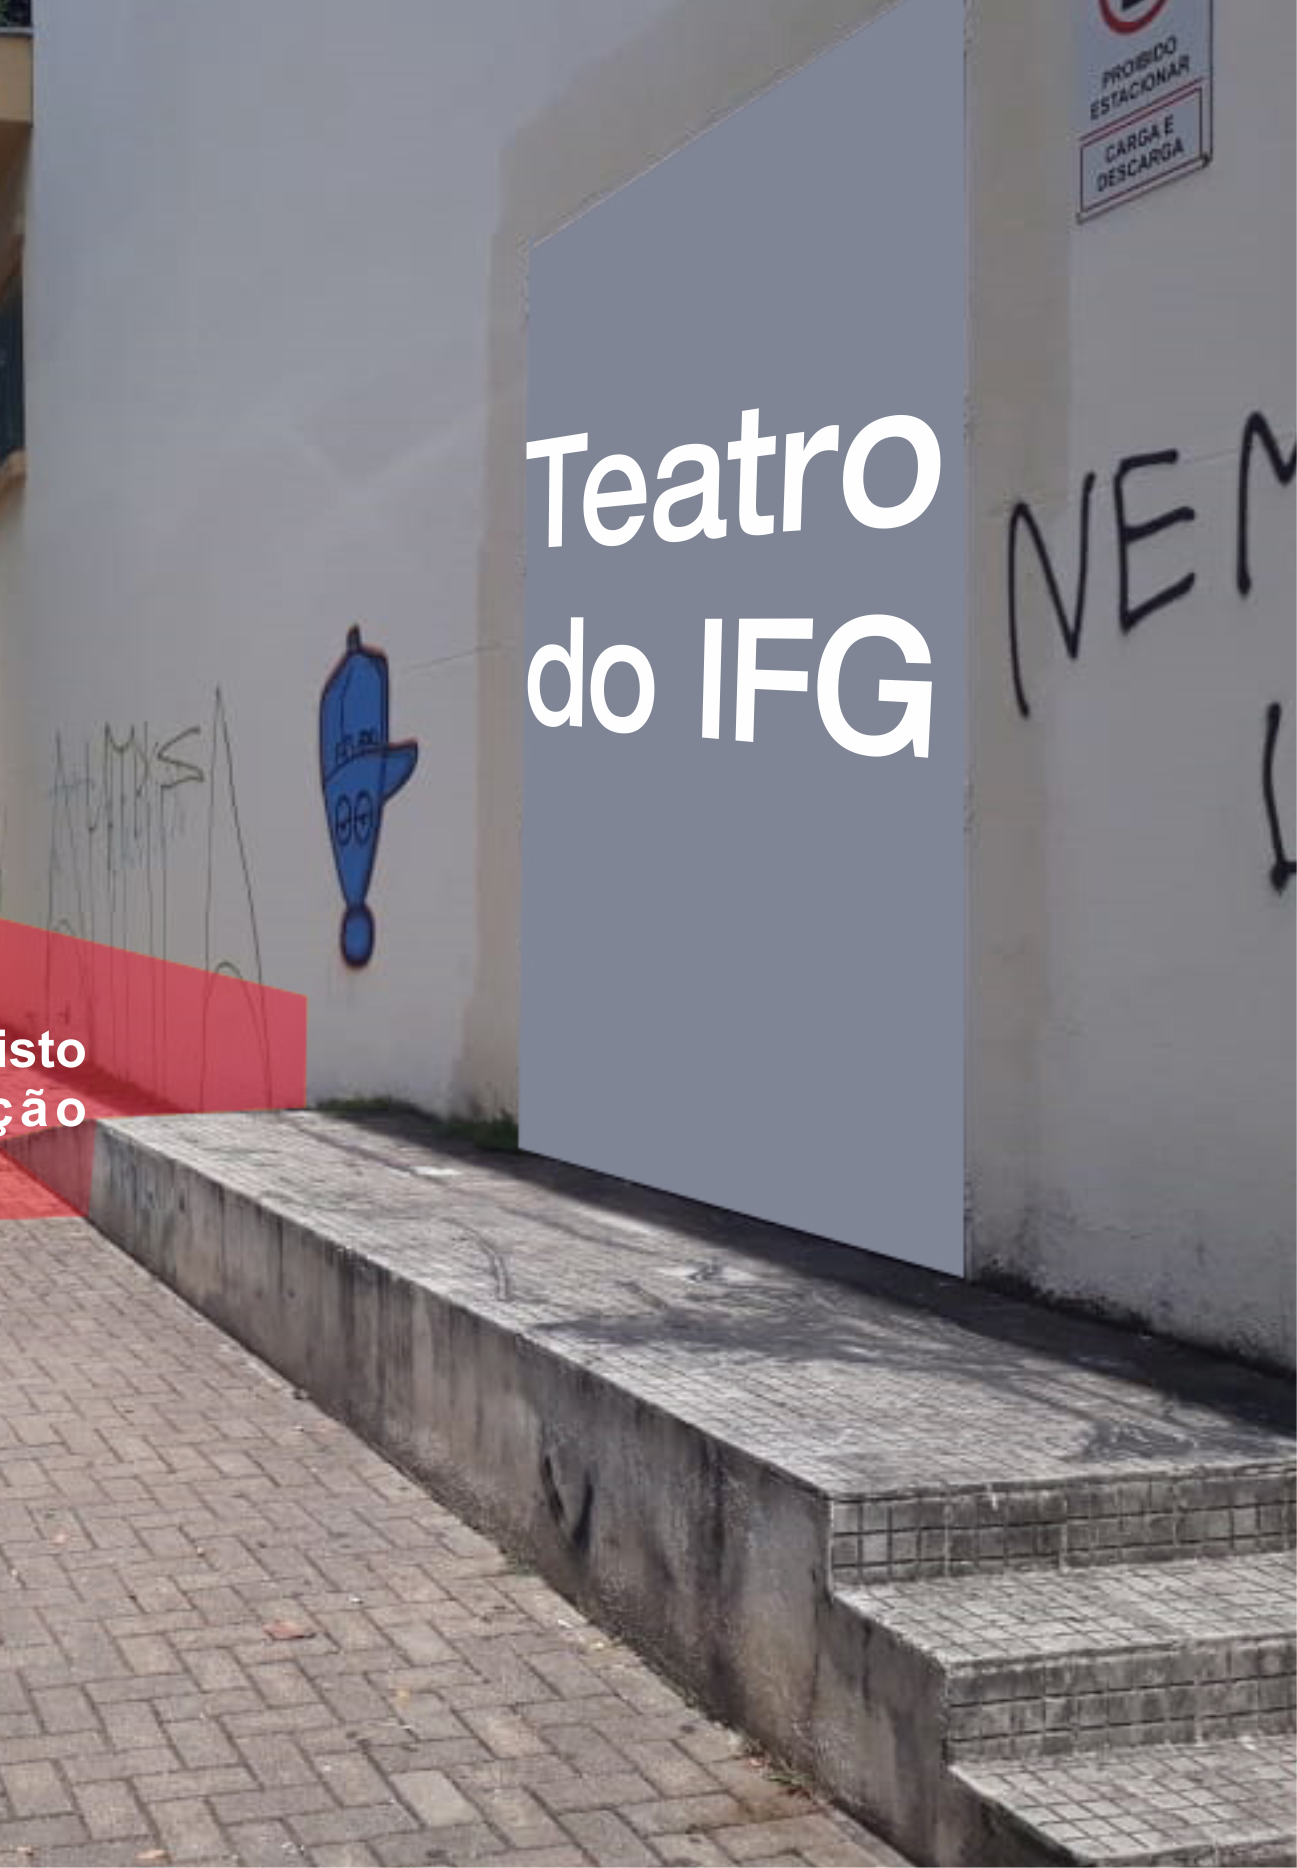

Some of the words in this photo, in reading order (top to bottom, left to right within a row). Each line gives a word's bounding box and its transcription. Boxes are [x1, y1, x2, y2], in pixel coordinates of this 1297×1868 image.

[1089, 54, 1190, 120] ESTACIONAR
[1102, 35, 1177, 88] PROIBIDO
[1095, 137, 1184, 192] DESCARGA
[1106, 123, 1160, 163] CARGA
[1164, 114, 1175, 135] E
